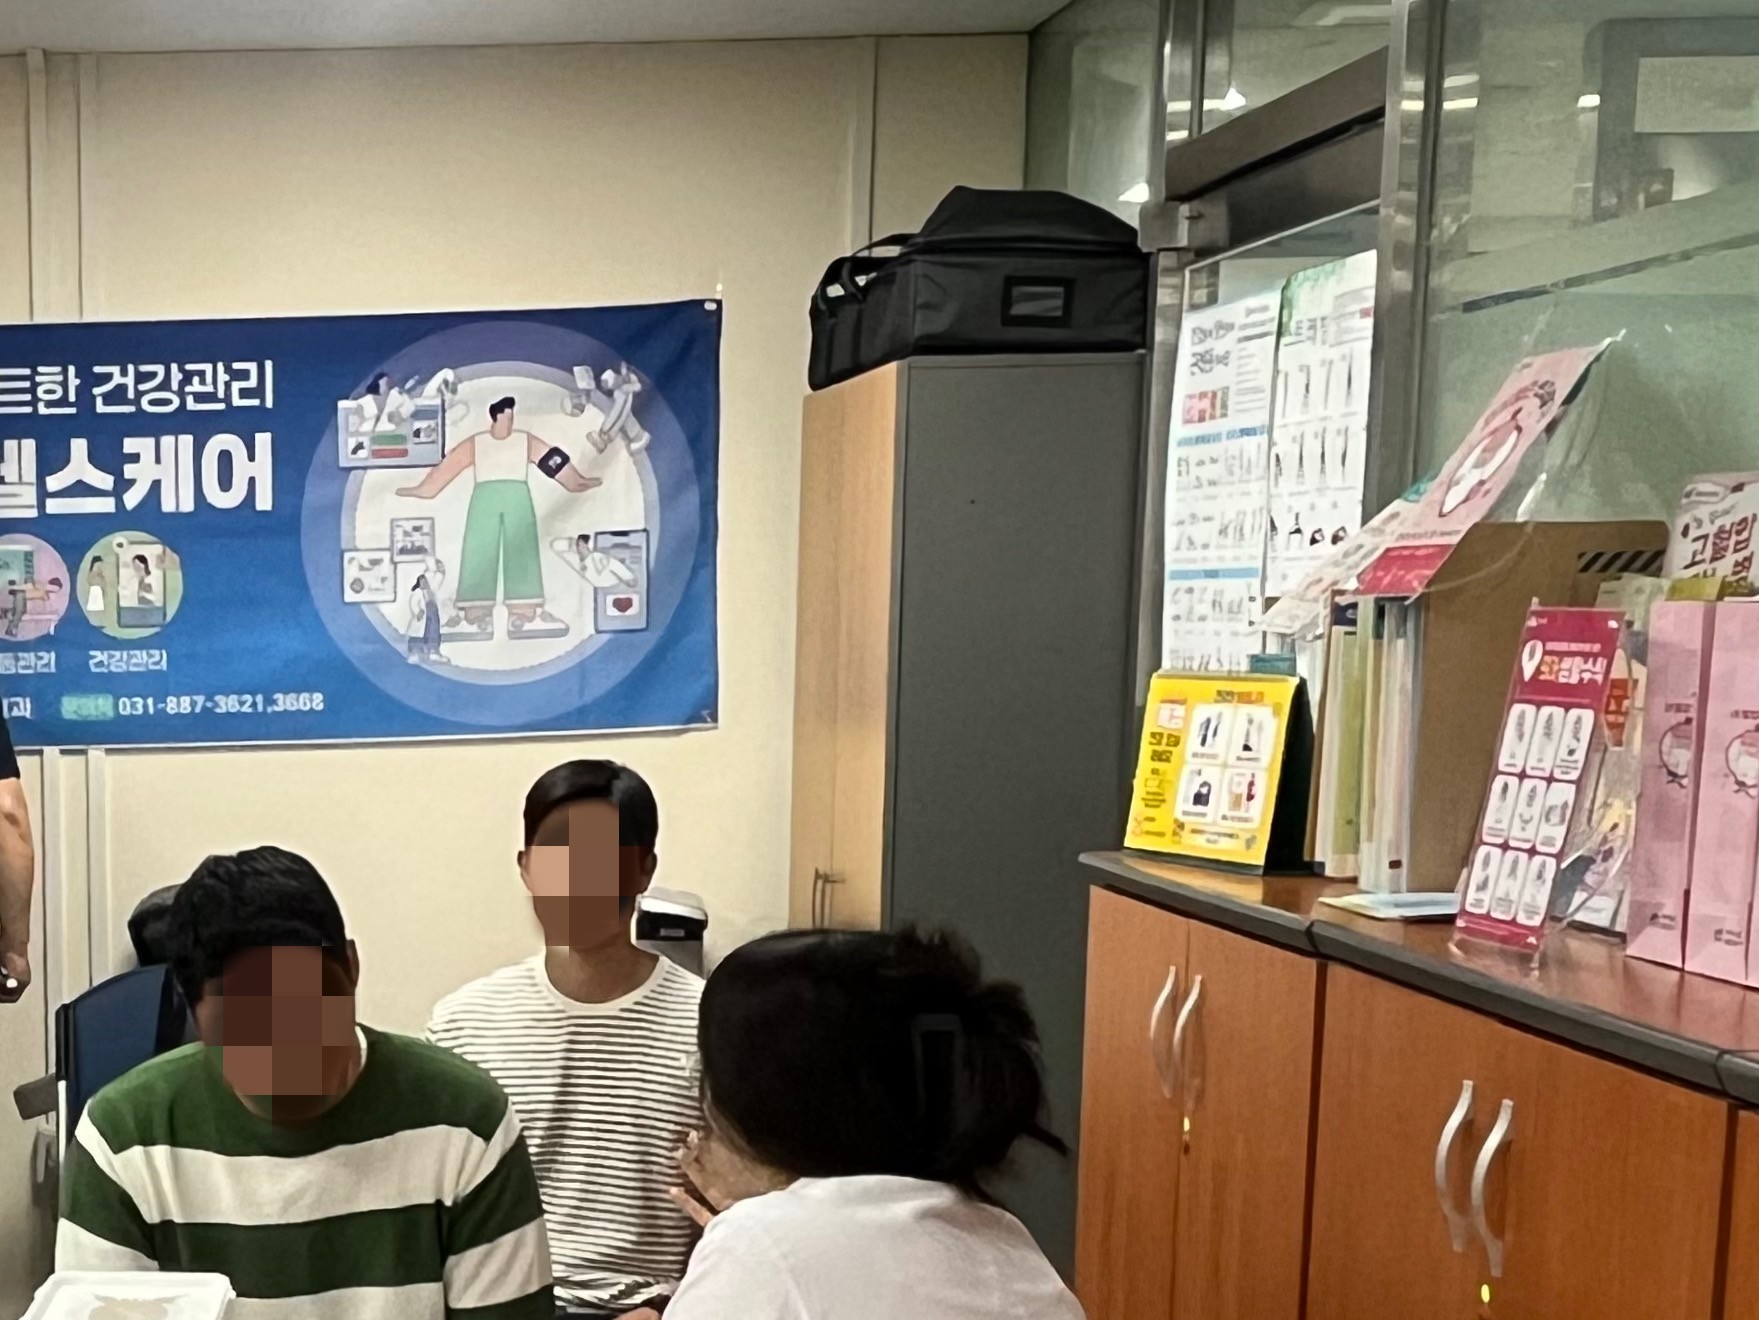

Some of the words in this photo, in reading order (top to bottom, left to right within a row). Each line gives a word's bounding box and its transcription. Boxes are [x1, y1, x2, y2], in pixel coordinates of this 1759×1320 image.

[92, 360, 274, 414] 건강관리
[88, 649, 168, 673] 건강관리
[117, 692, 325, 716] 031-887-3621,3668
